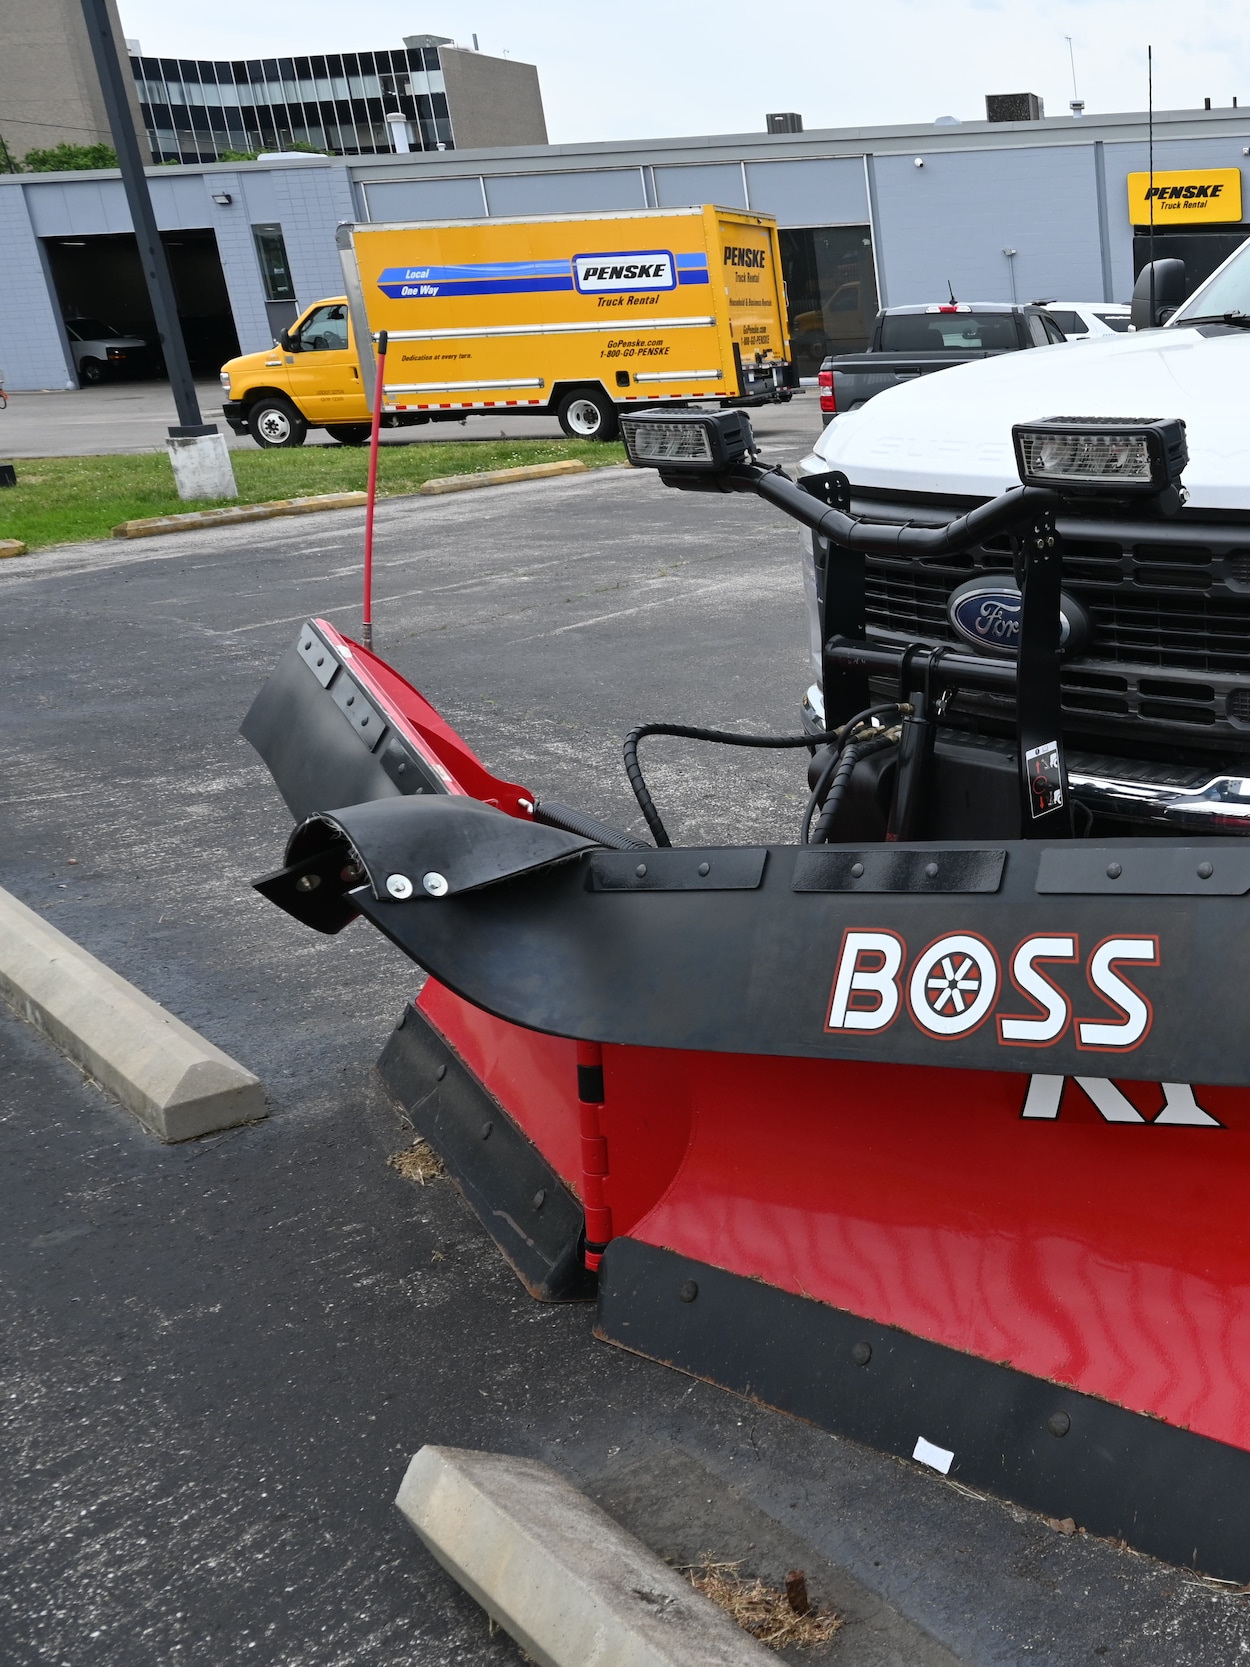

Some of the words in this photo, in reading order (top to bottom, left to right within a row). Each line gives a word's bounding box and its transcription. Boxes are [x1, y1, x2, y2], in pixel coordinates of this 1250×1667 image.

[1144, 184, 1224, 200] PENSKE
[1160, 201, 1181, 210] Truck
[1182, 200, 1207, 209] Rental
[724, 246, 765, 269] PENSKE
[405, 268, 430, 279] Local
[583, 264, 666, 281] PENSKE
[735, 271, 746, 282] Truck
[747, 272, 760, 282] Rental
[401, 286, 419, 296] One
[420, 284, 440, 297] Way
[597, 296, 624, 307] Truck
[626, 294, 660, 306] Rental
[607, 339, 664, 349] GoPenske.com
[600, 347, 670, 358] 1-800-GO-PENSKE
[975, 600, 1021, 638] For
[824, 928, 1161, 1053] BOSS
